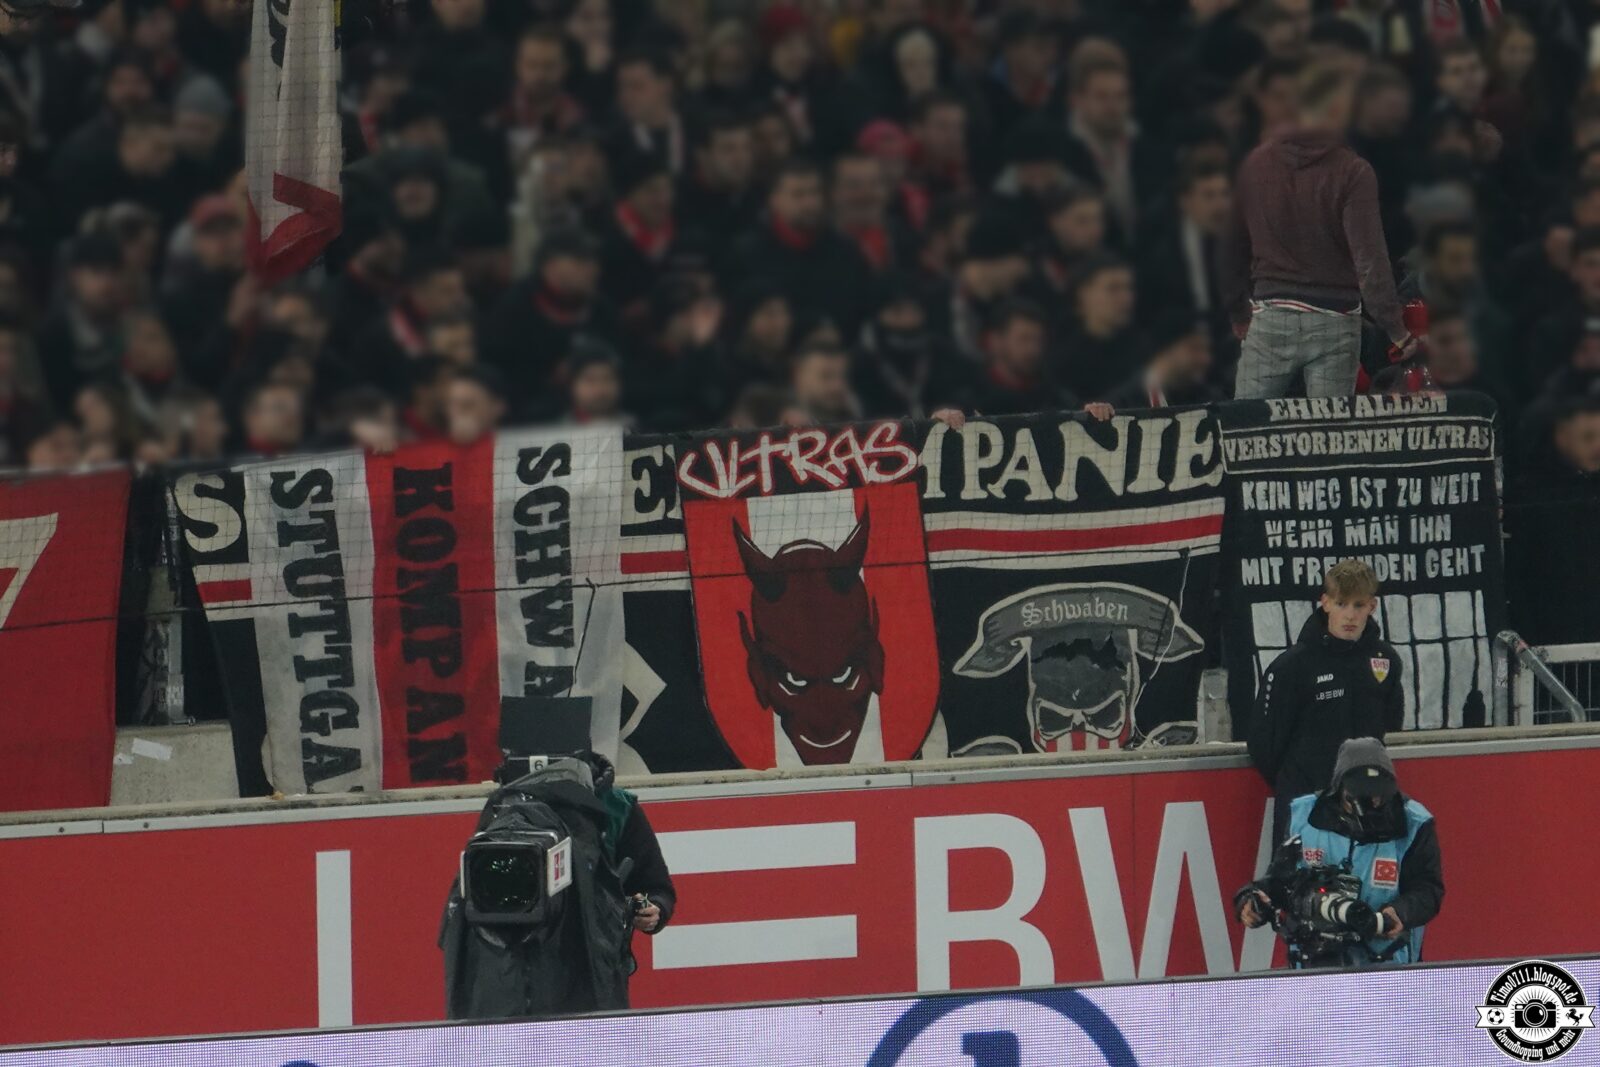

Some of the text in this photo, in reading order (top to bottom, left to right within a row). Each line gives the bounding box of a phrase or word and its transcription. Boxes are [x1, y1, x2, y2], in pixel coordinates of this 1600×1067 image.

[1266, 396, 1350, 422] EHRE
[1223, 425, 1490, 462] VERSTORBENEN ULTRAS
[1241, 472, 1481, 511] KEIN WEG IST ZU WEIT
[1264, 514, 1451, 548] WENN MAN IHN
[1241, 544, 1485, 586] MIT FRDEN GEHT
[1020, 596, 1128, 627] Schwaben
[270, 468, 364, 795] STUTTGA
